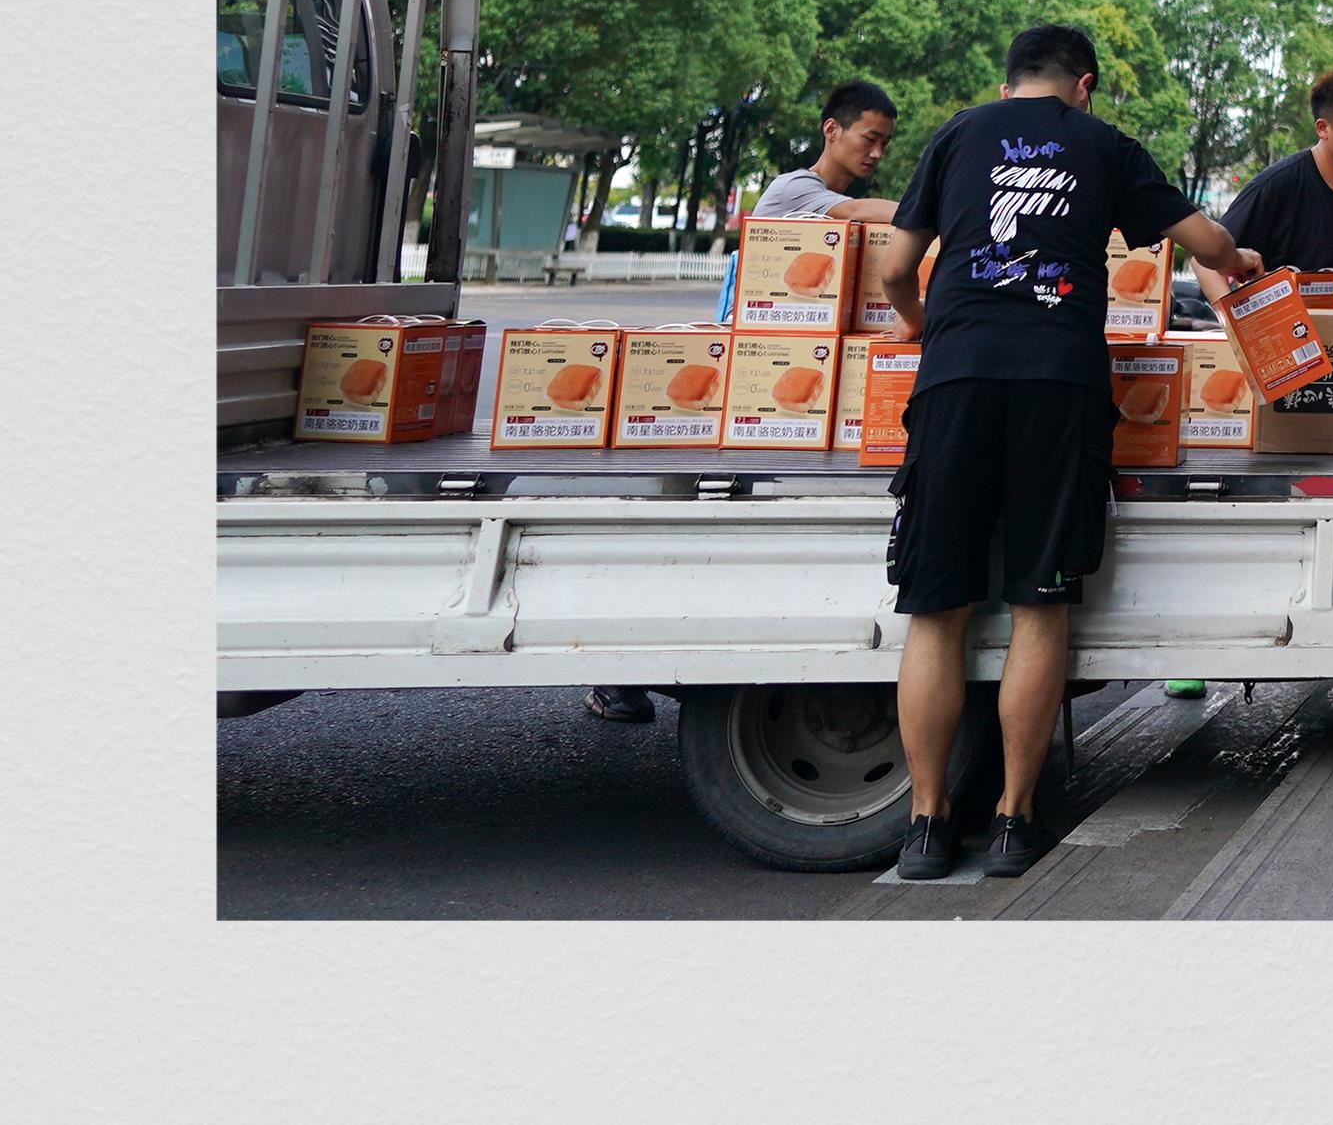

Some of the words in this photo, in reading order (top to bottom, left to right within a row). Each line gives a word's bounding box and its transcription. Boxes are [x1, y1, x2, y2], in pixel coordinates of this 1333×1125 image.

[745, 310, 829, 322] 南星骆驼奶蛋糕
[305, 418, 380, 431] 南星骆驼奶蛋糕
[627, 424, 713, 437] 南星骆驼奶蛋糕
[504, 425, 596, 438] 南星骆驼奶蛋糕
[733, 426, 817, 438] 南星骆驼奶蛋糕
